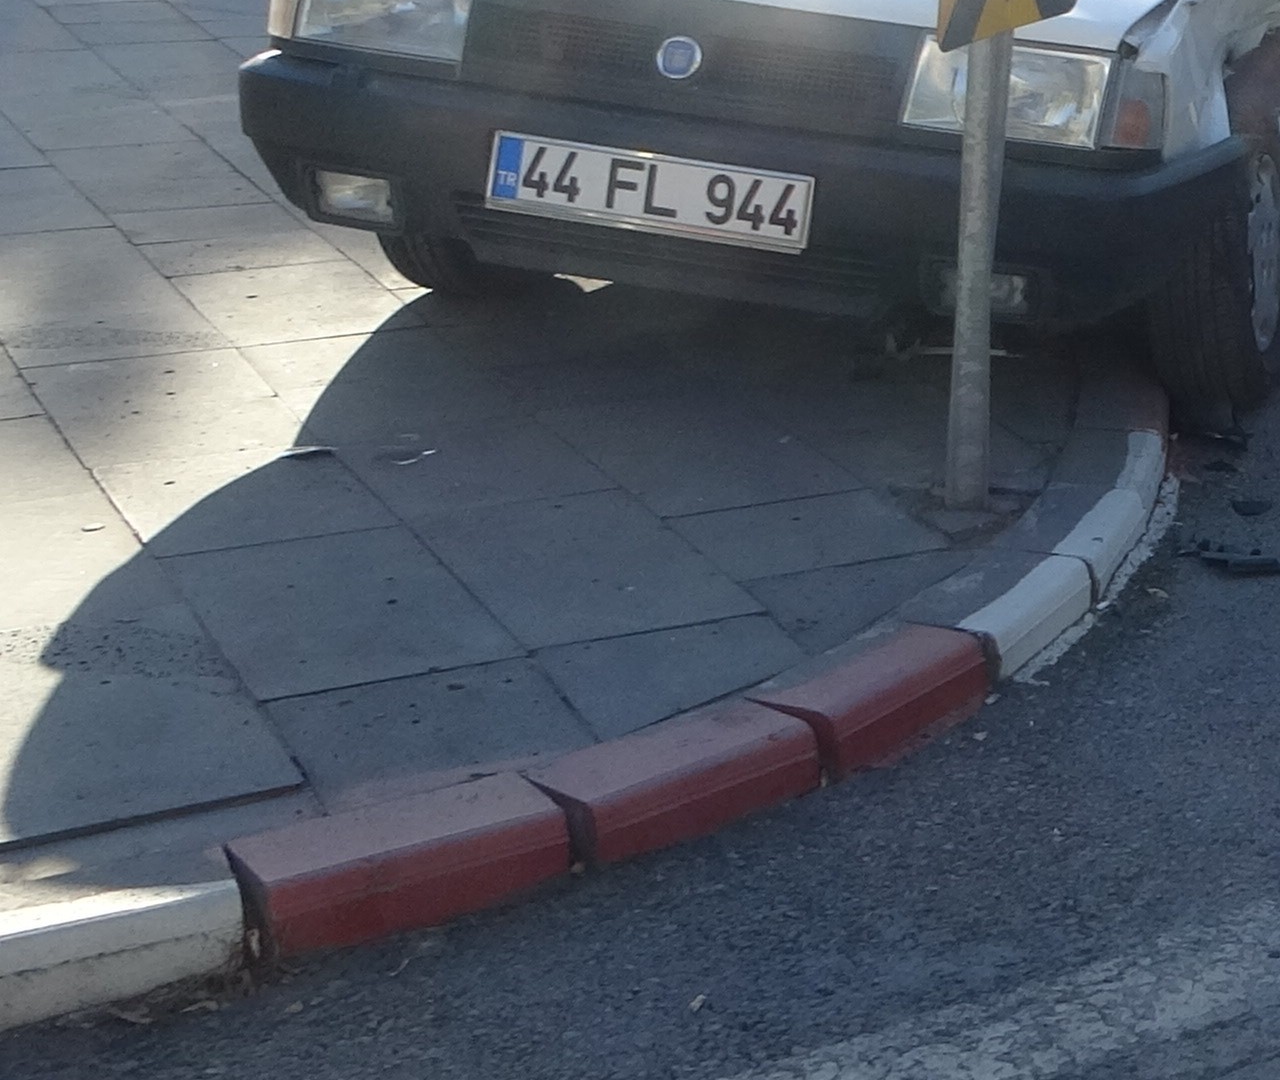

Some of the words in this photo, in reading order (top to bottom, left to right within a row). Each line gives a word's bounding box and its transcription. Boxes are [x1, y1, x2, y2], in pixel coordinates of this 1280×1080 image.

[498, 170, 517, 187] TR
[522, 146, 581, 203] 44
[605, 158, 677, 218] FL
[705, 174, 798, 236] 944
